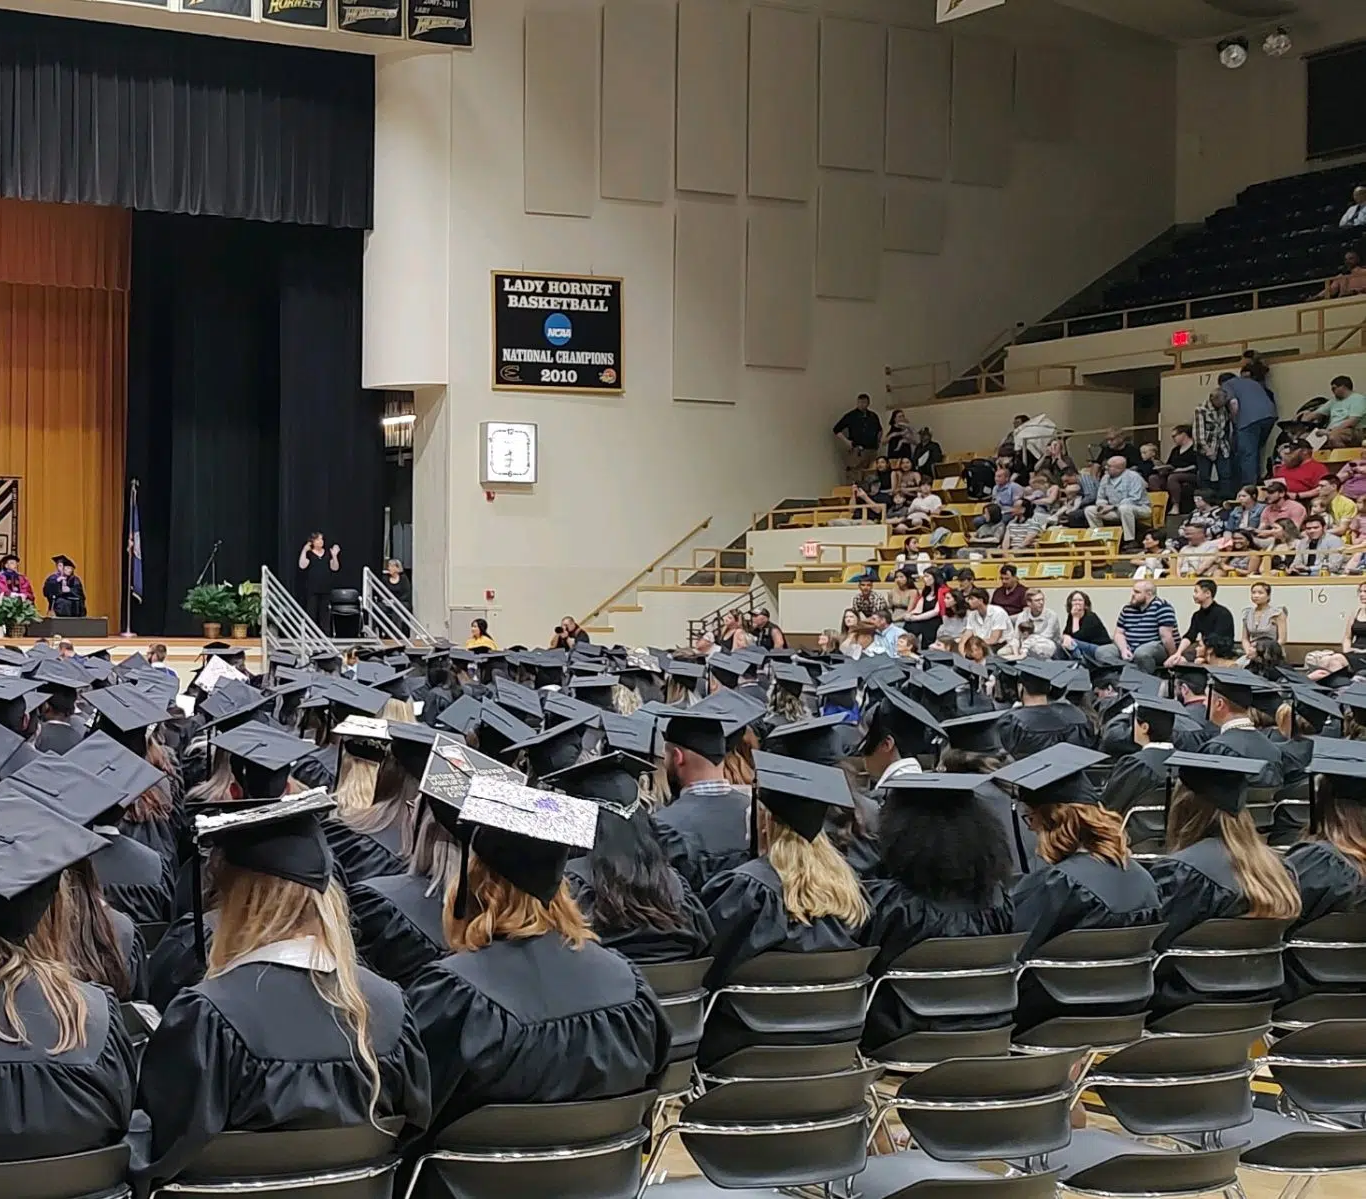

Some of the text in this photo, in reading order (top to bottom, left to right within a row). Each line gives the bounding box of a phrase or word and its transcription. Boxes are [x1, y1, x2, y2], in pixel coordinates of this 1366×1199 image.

[503, 278, 612, 297] LADY HORNET
[507, 294, 609, 312] BASKETBALL
[547, 327, 572, 339] NCAA
[502, 348, 615, 365] NATIONAL CHAMPIONS
[540, 368, 578, 383] 2010
[1198, 374, 1211, 386] 17
[1309, 588, 1328, 604] 16
